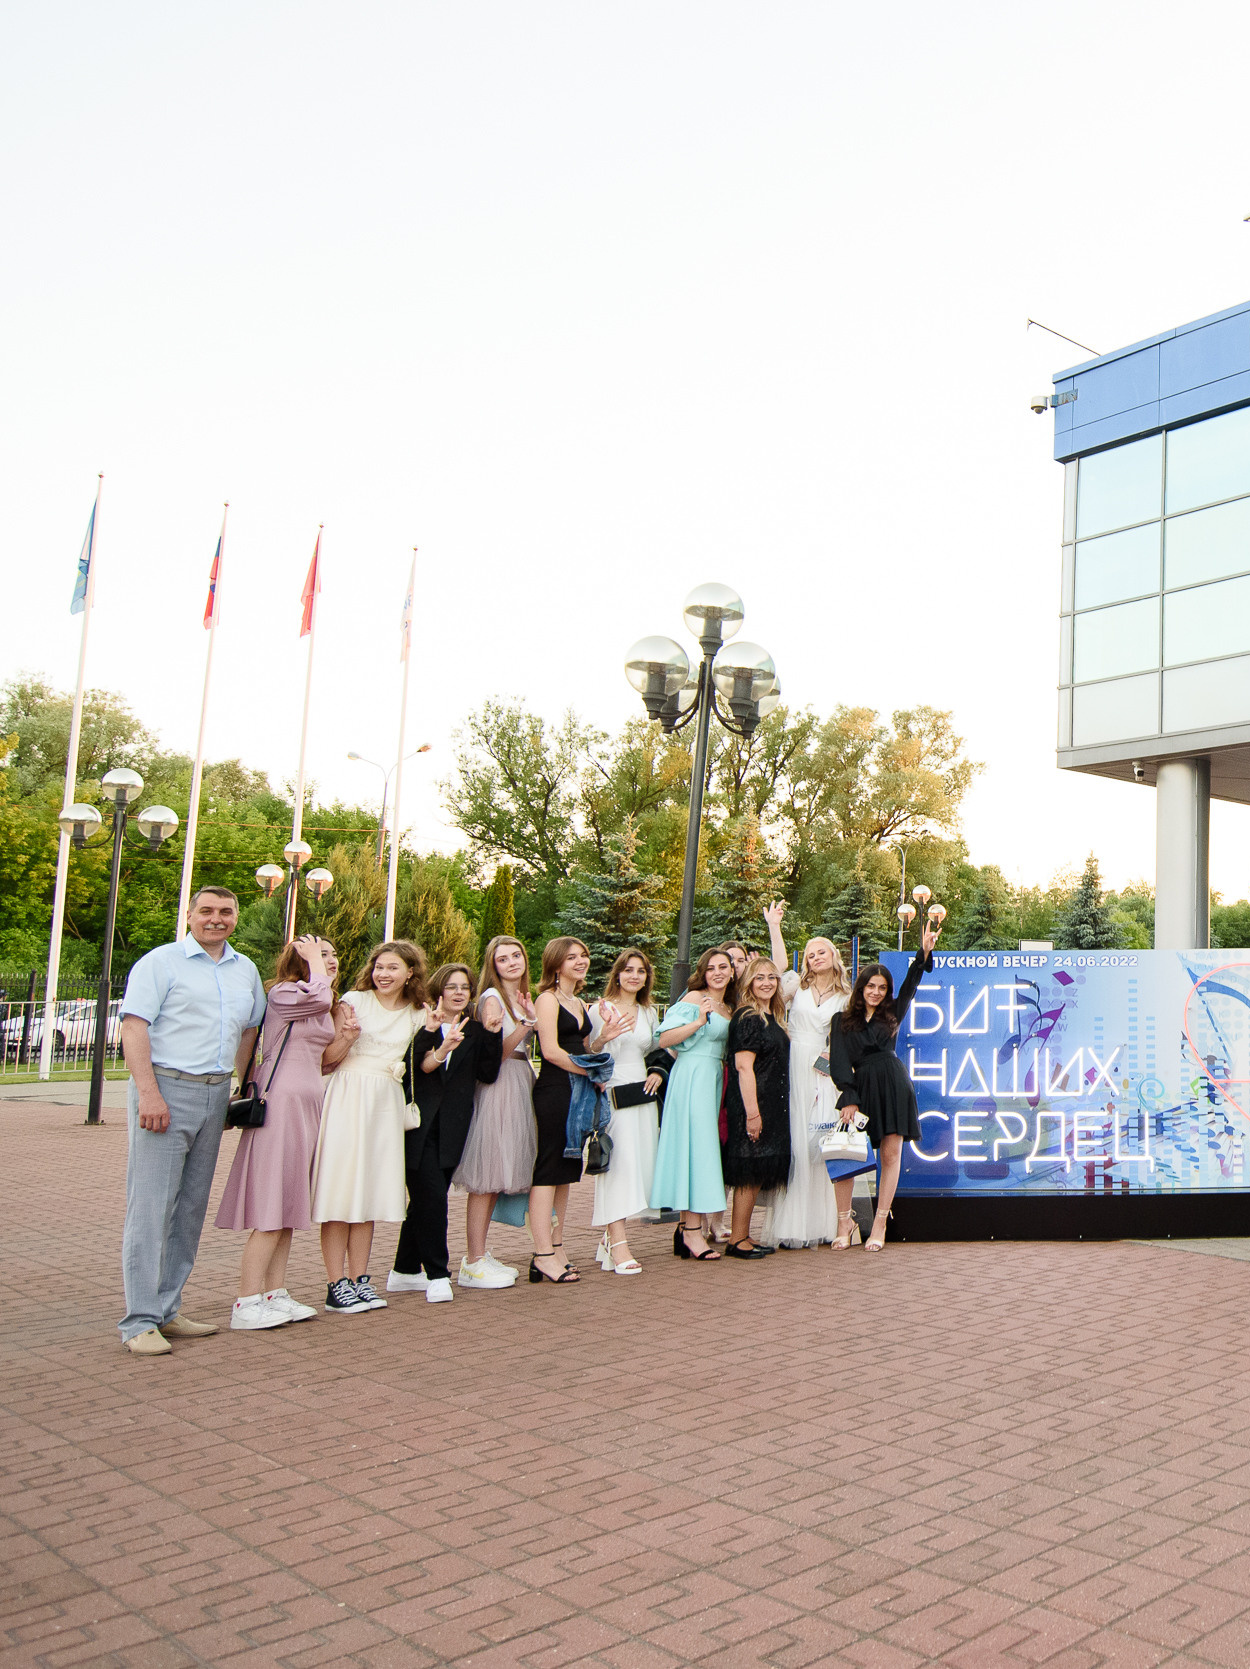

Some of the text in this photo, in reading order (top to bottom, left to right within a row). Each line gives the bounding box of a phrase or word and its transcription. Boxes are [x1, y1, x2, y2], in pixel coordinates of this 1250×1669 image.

[908, 953, 1139, 968] ПУСКНОЙ ВЕЧЕР 24.06.2022
[910, 984, 1032, 1034] БИТ
[908, 1046, 1122, 1098] НАШИХ
[909, 1111, 1155, 1174] СЕРДЕЦ
